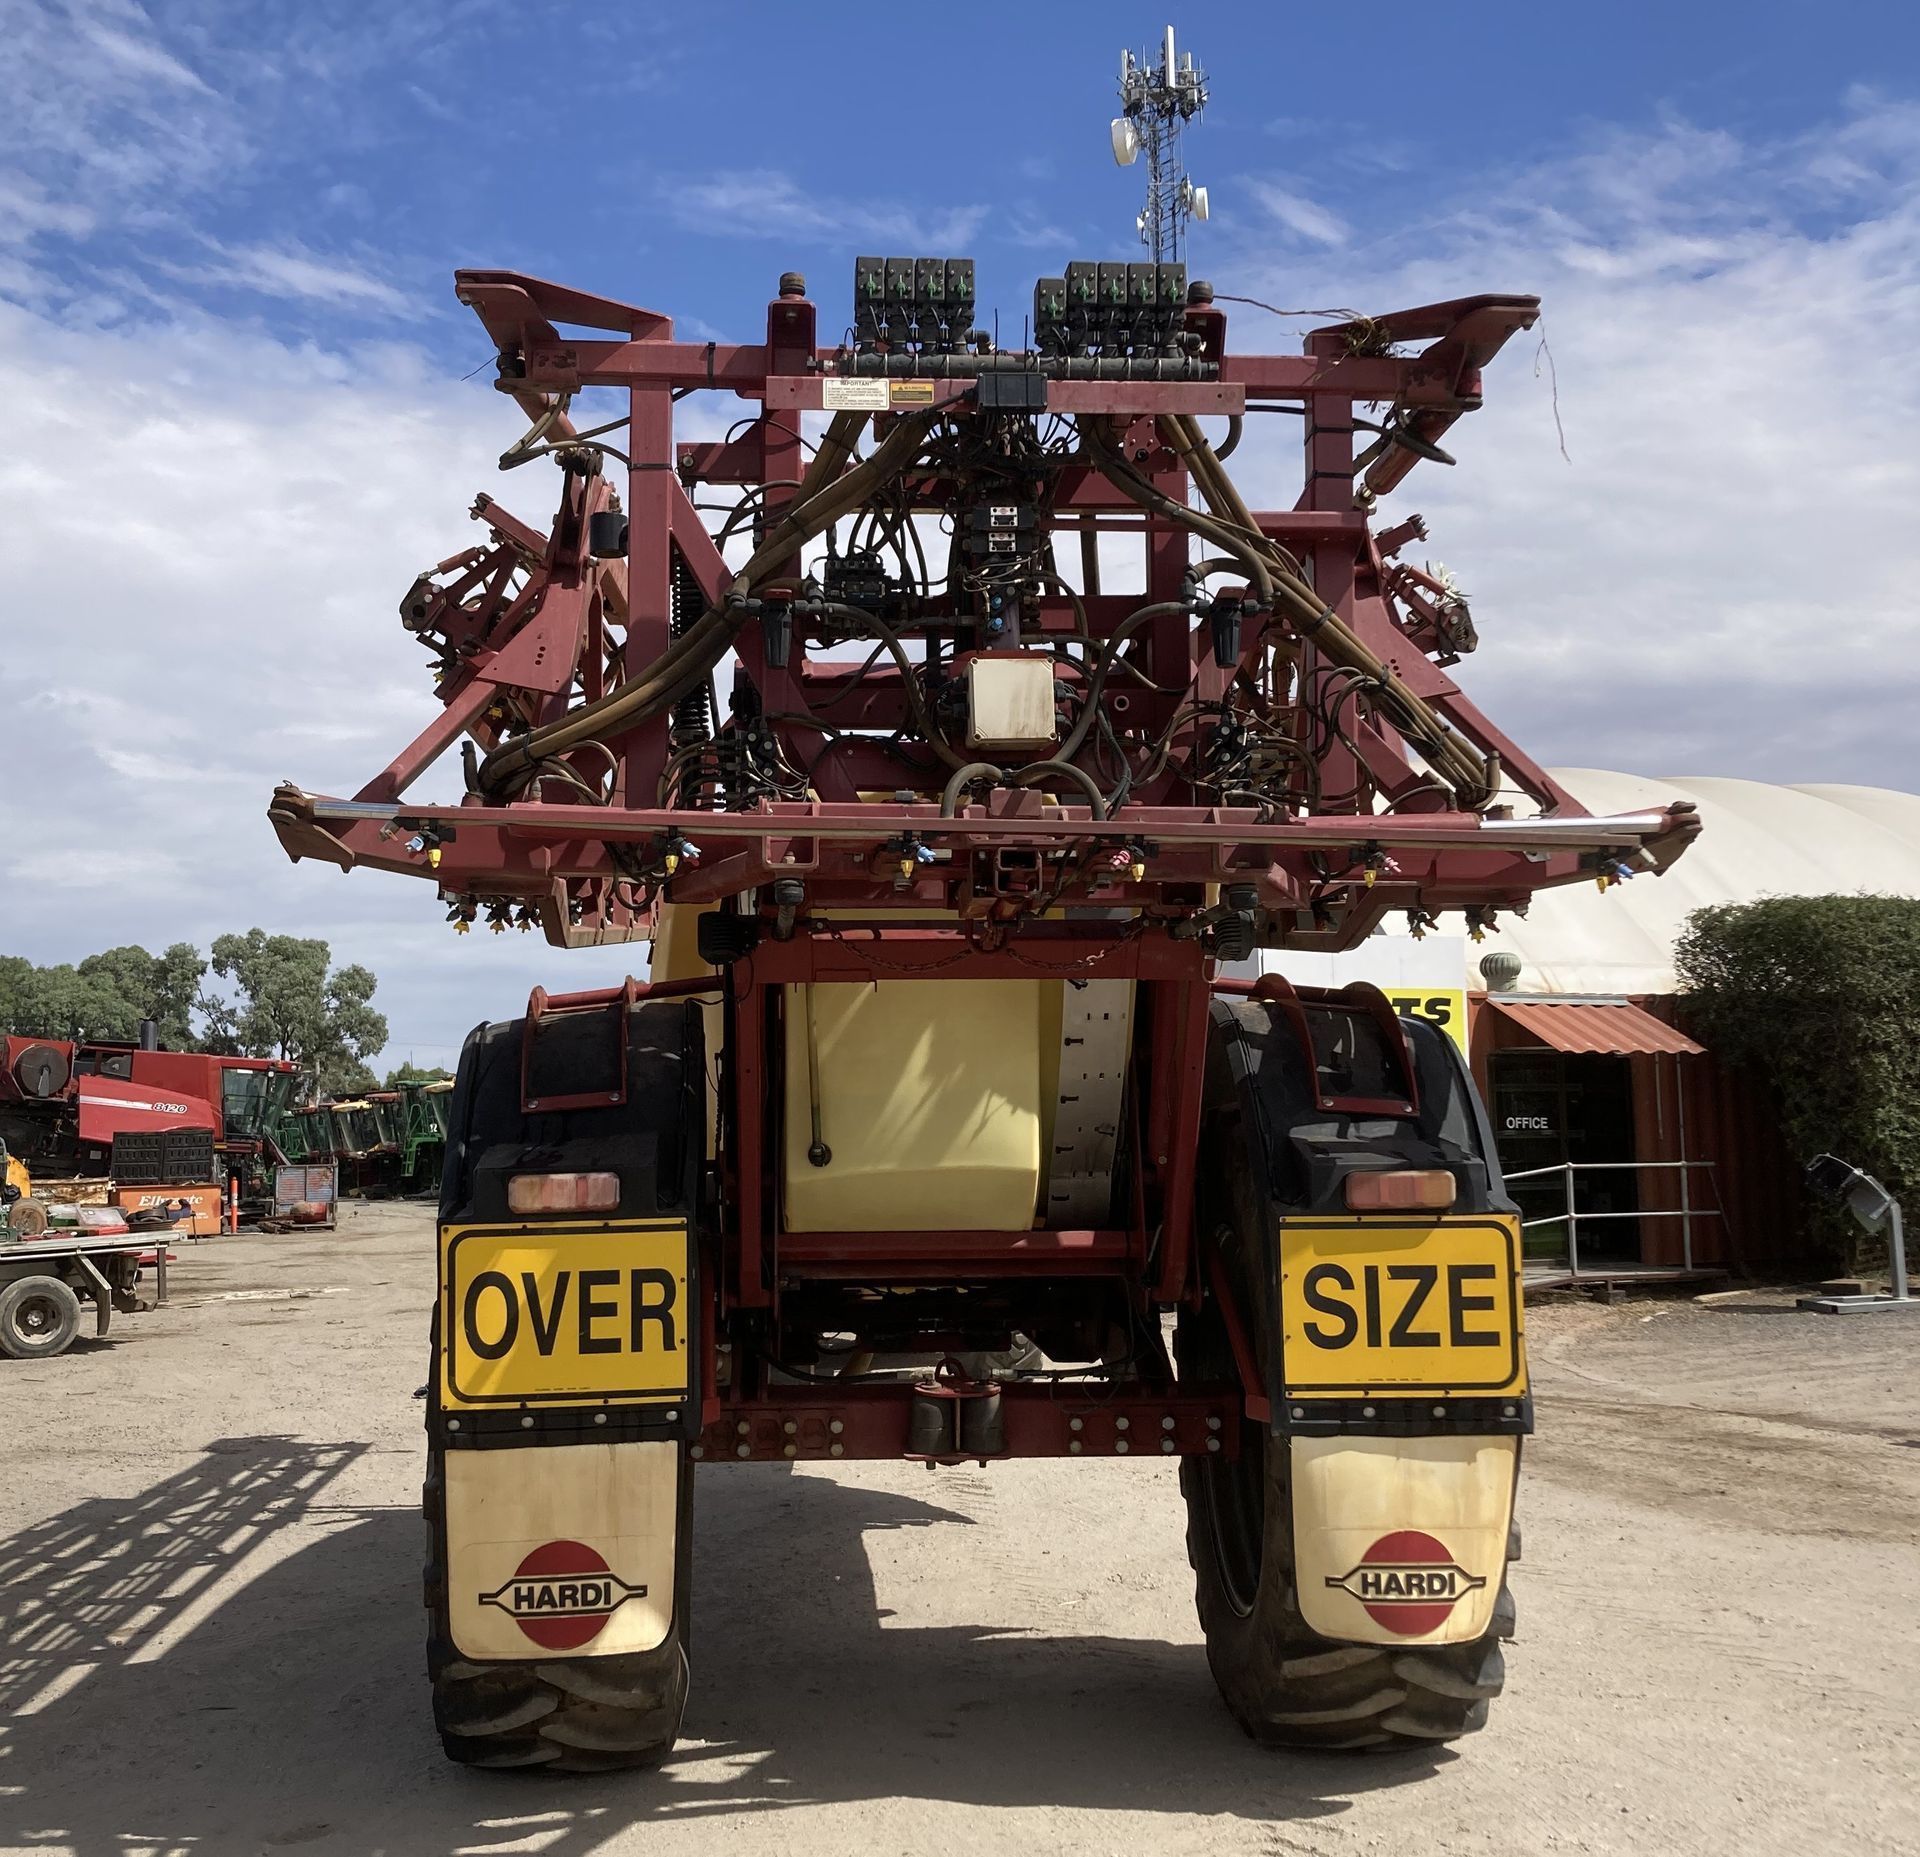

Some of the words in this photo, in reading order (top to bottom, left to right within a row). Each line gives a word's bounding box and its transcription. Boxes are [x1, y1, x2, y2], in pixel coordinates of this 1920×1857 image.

[153, 1102, 187, 1114] 8120
[1506, 1116, 1549, 1129] OFFICE
[463, 1268, 678, 1361] OVER
[1303, 1263, 1502, 1350] SIZE
[513, 1581, 612, 1611] HARDI
[1361, 1572, 1457, 1596] HARDI
